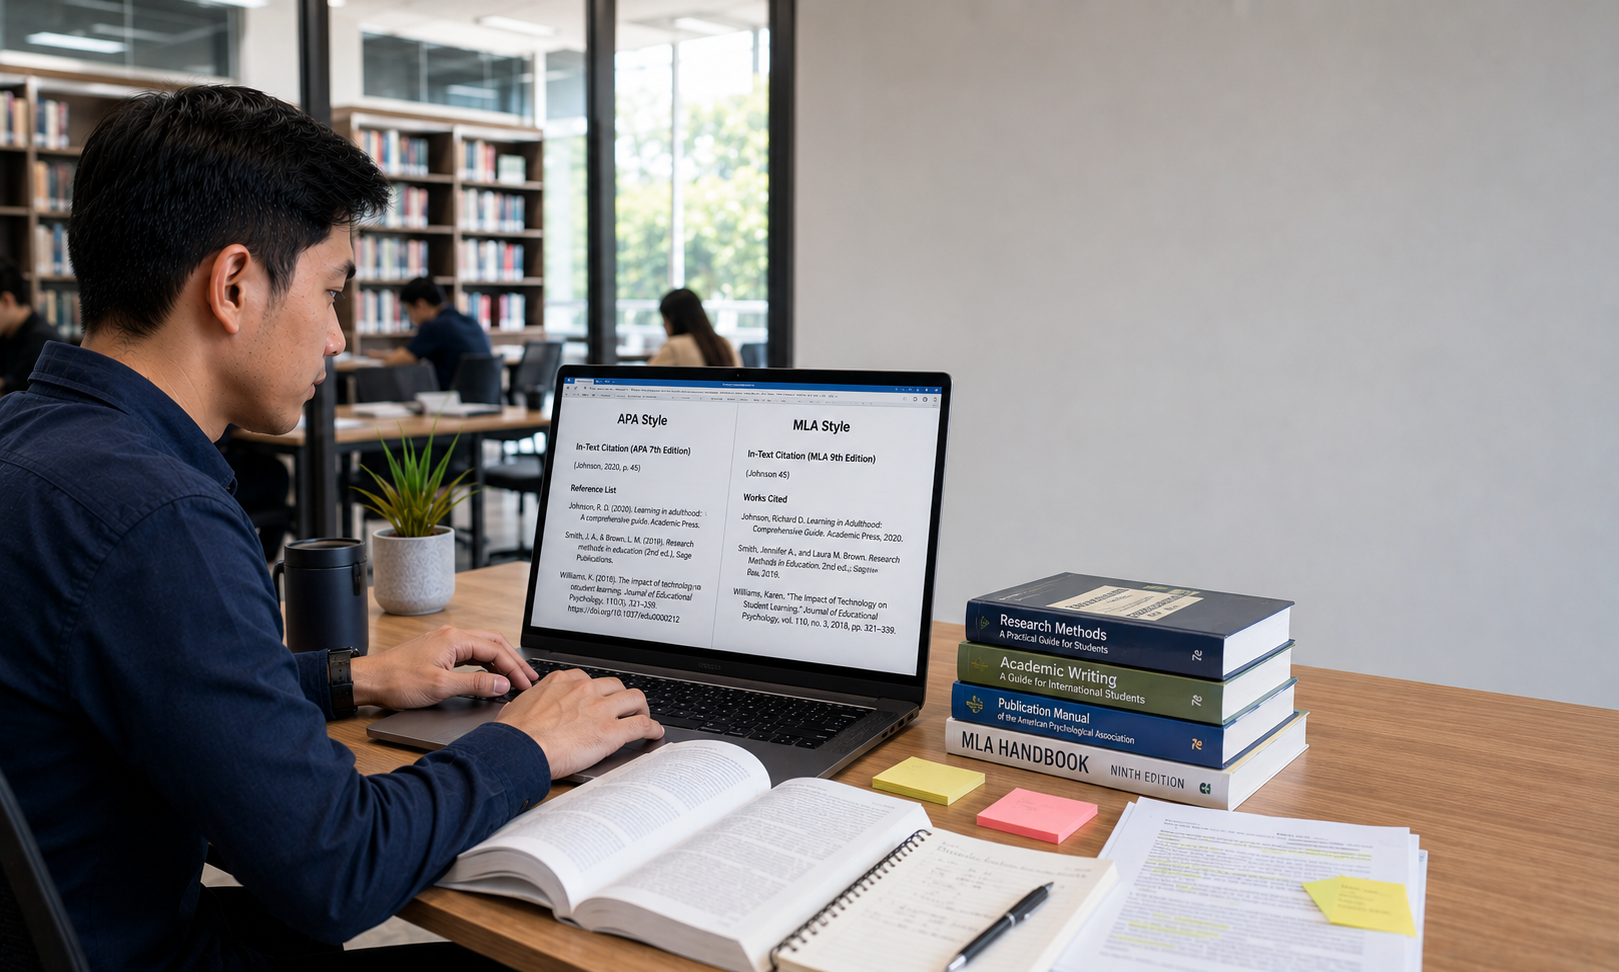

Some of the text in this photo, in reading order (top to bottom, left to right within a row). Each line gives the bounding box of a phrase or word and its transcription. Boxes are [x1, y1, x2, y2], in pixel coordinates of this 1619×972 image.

[617, 413, 668, 428] APA Style
[793, 419, 850, 435] MLA Style
[576, 442, 691, 457] In-Text Citation (APA 7th Edition)
[748, 450, 876, 465] In-Text Citation (MLA 9th Edition)
[574, 461, 603, 471] (Johnson,
[604, 463, 622, 472] 2020,
[630, 464, 641, 473] 45)
[746, 470, 790, 480] (Johnson 45)
[570, 484, 616, 494] Reference List
[744, 493, 788, 504] Works Cited
[1000, 614, 1107, 641] Research Methods
[999, 630, 1109, 654] A Practical Guide for Students
[1192, 649, 1202, 661] 7e
[1000, 656, 1117, 688] Academic Writing
[1000, 672, 1146, 704] A Guide for International Students
[998, 697, 1090, 724] Publication Manual
[1006, 714, 1017, 723] the
[1018, 716, 1048, 728] American
[1192, 738, 1202, 750] 7e
[962, 731, 1089, 774] MLA HANDBOOK
[1111, 764, 1184, 790] NINTH EDITION
